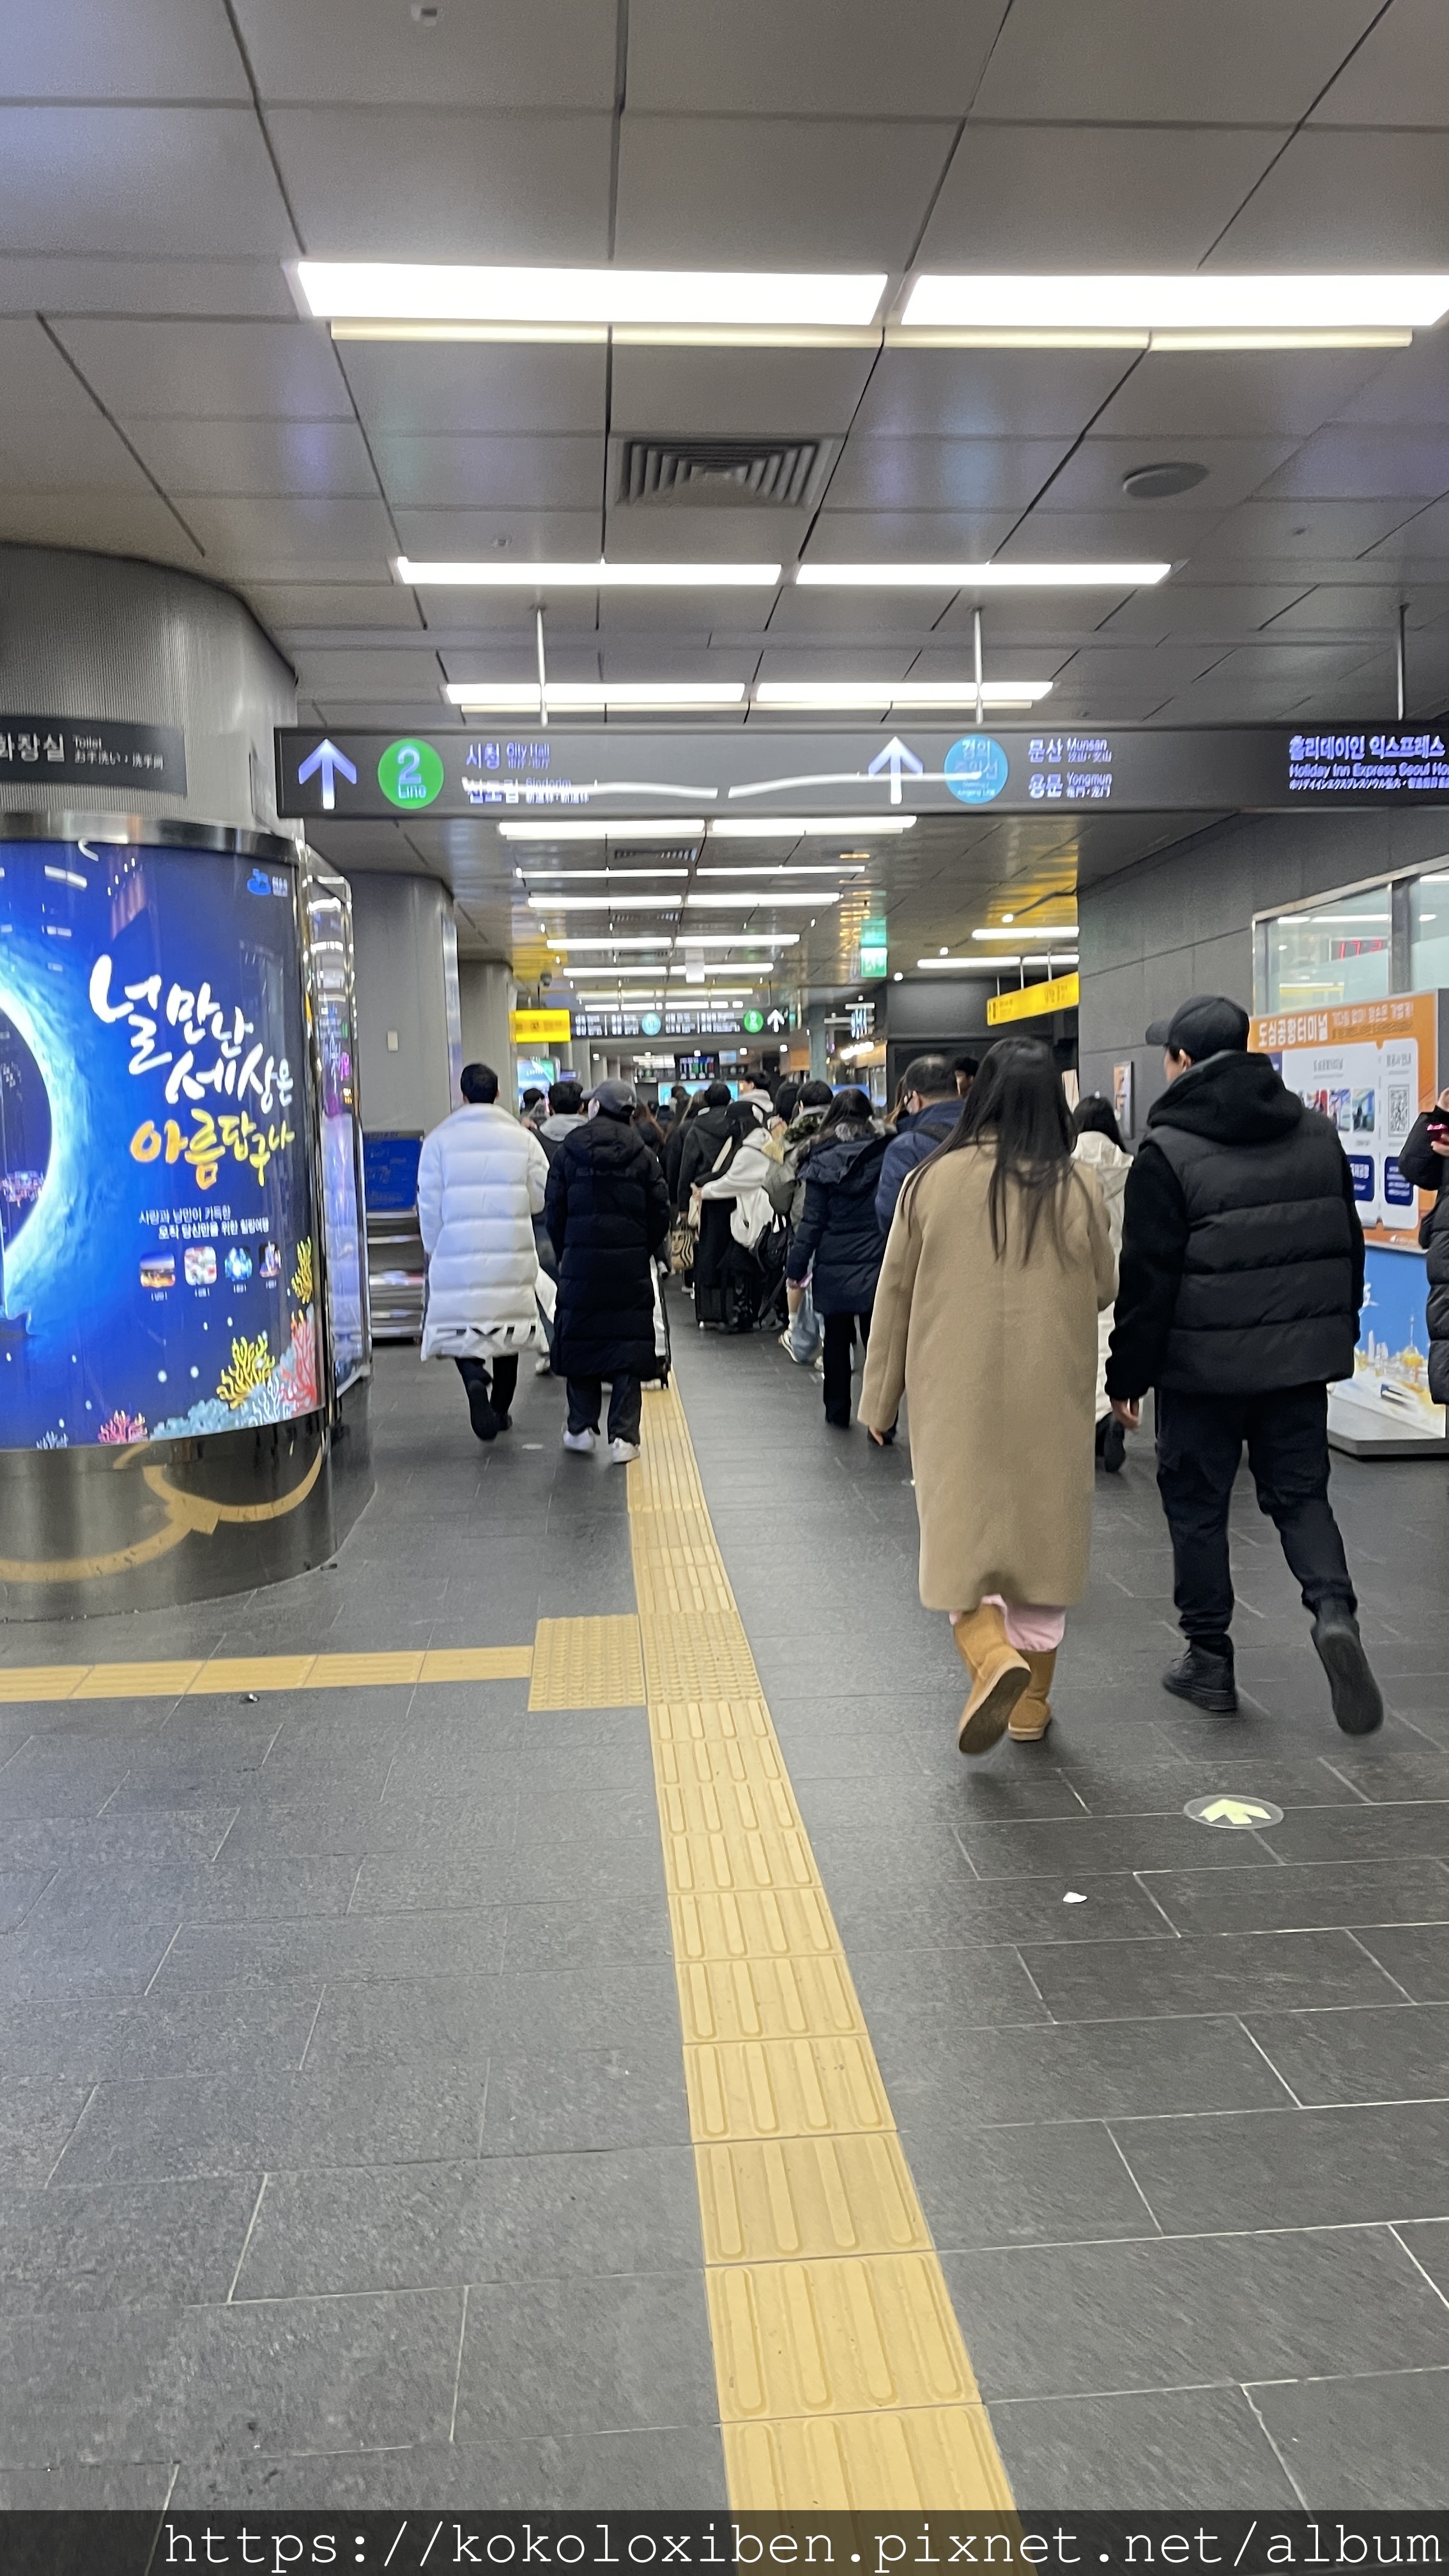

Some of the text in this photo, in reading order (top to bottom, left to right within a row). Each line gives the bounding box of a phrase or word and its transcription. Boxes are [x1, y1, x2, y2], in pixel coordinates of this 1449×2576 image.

[466, 742, 501, 770] 시청
[1028, 737, 1064, 763] 문산
[1066, 737, 1108, 751] Munsan
[1289, 735, 1446, 761] 홀리데이인 익스프레스
[397, 745, 422, 784] 2
[1028, 772, 1064, 799] 용문
[1066, 771, 1113, 787] Yongmun
[89, 954, 254, 1075] 널 만난
[1258, 1012, 1328, 1048] 도심공항터미널
[165, 1043, 294, 1114] 세상은
[130, 1108, 296, 1190] 아름답구나
